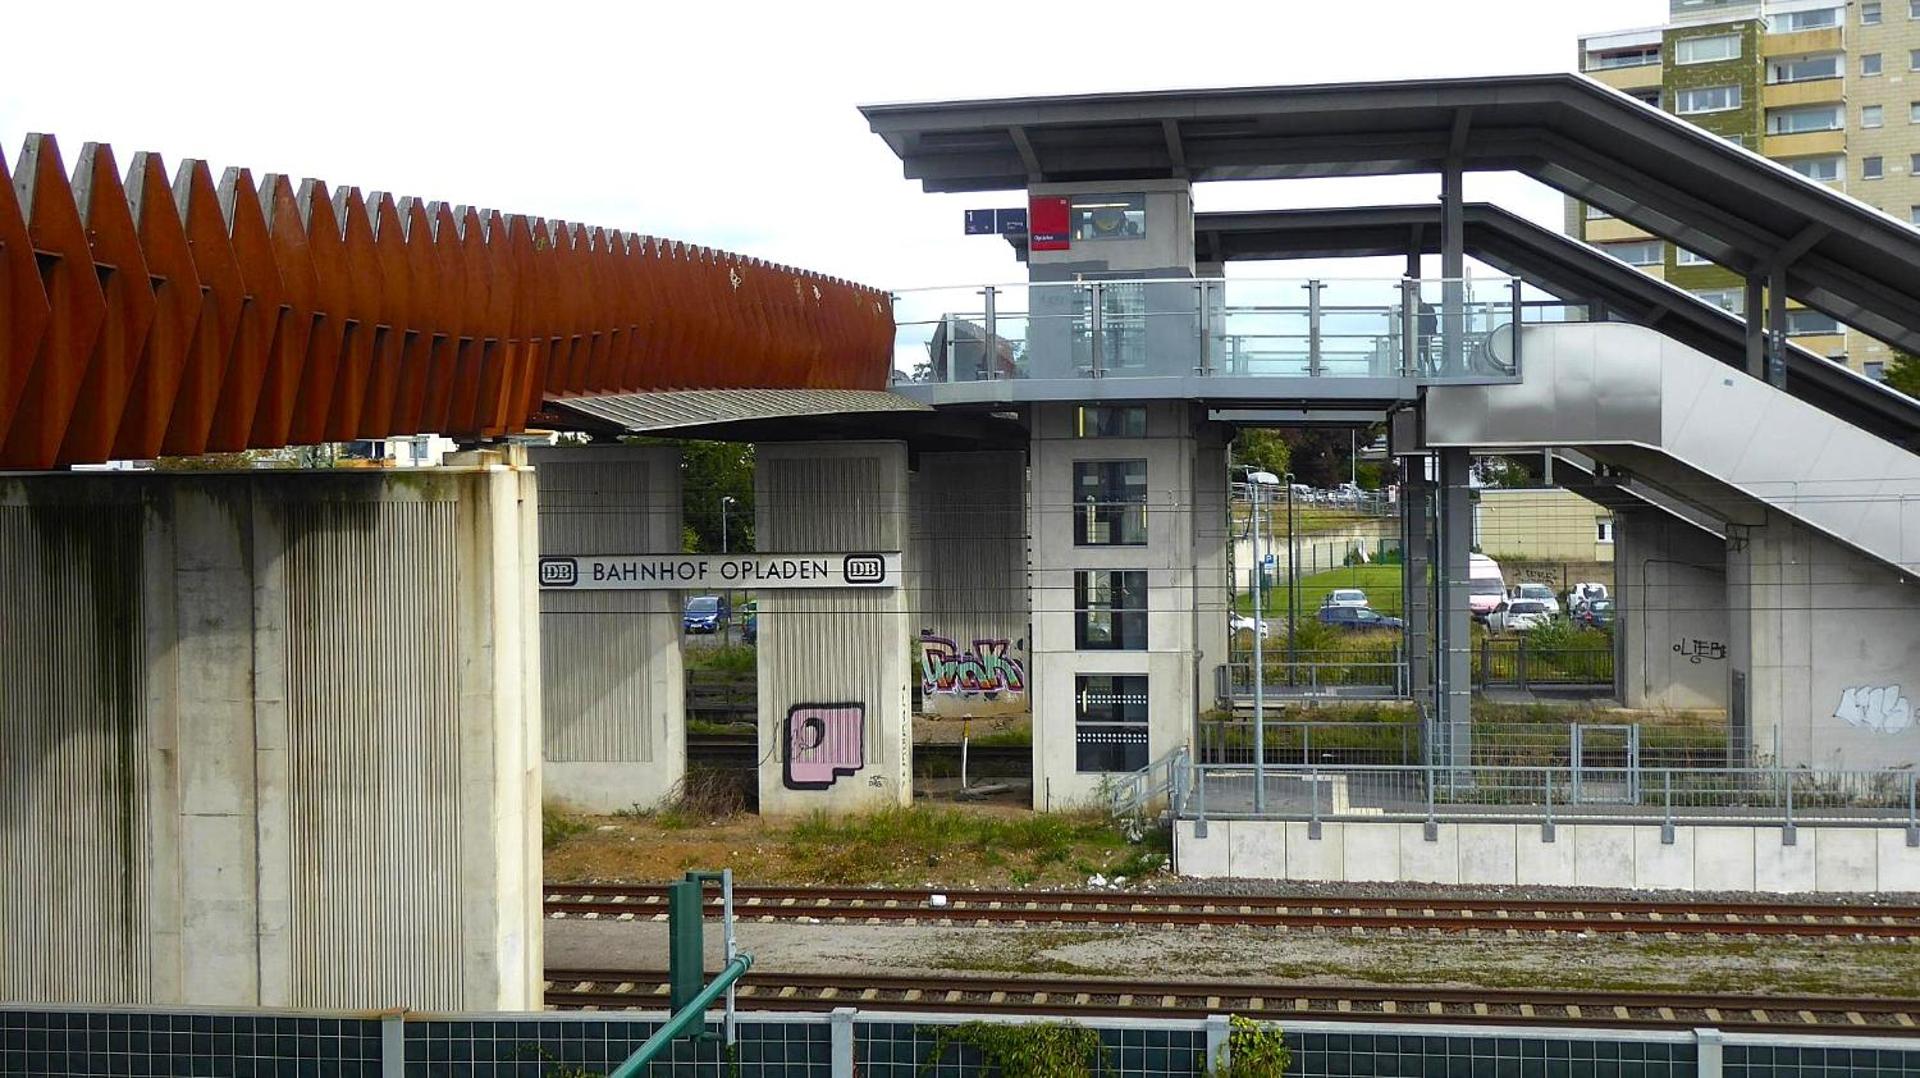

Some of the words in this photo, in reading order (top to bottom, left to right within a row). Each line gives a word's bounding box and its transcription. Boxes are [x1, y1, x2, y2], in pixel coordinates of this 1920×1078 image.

[967, 211, 973, 222] 1
[593, 561, 708, 581] BAHNHOF
[720, 560, 828, 580] OPLADEN
